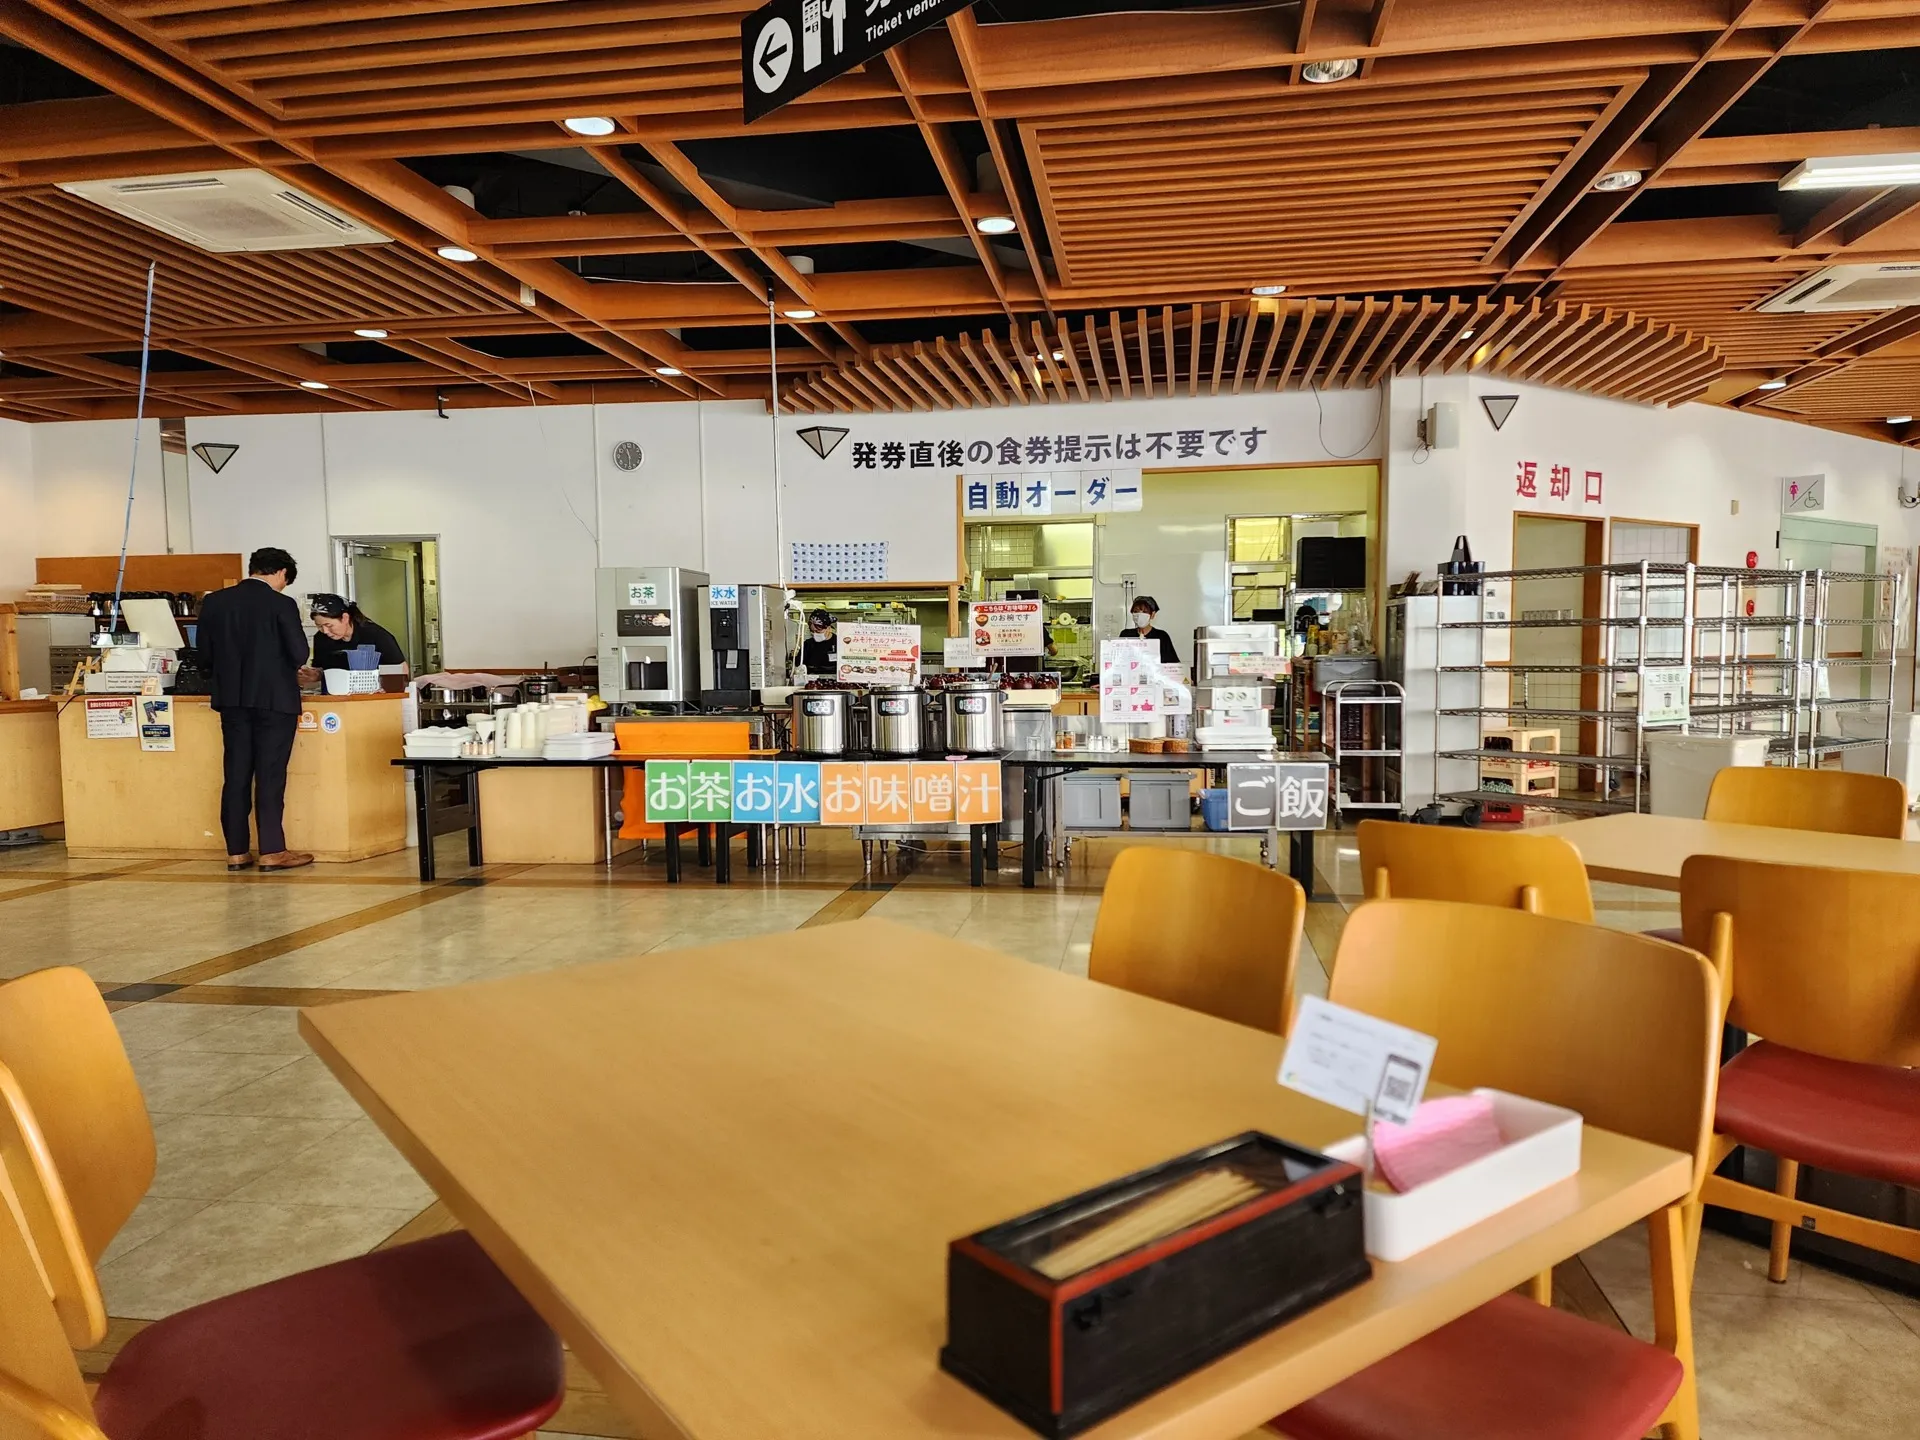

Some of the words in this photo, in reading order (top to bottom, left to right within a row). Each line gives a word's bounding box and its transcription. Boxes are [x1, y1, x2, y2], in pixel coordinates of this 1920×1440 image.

[865, 12, 902, 42] Ticket
[852, 427, 1267, 469] 発券直後の食券提示は不要です
[968, 476, 1138, 511] 自動オーダー
[1516, 461, 1603, 504] 返却口
[631, 587, 654, 599] お茶
[712, 587, 736, 599] 氷水
[650, 771, 730, 812] お茶
[736, 772, 818, 813] お水
[825, 773, 998, 814] お味噌汁
[1235, 775, 1326, 819] ご飯
